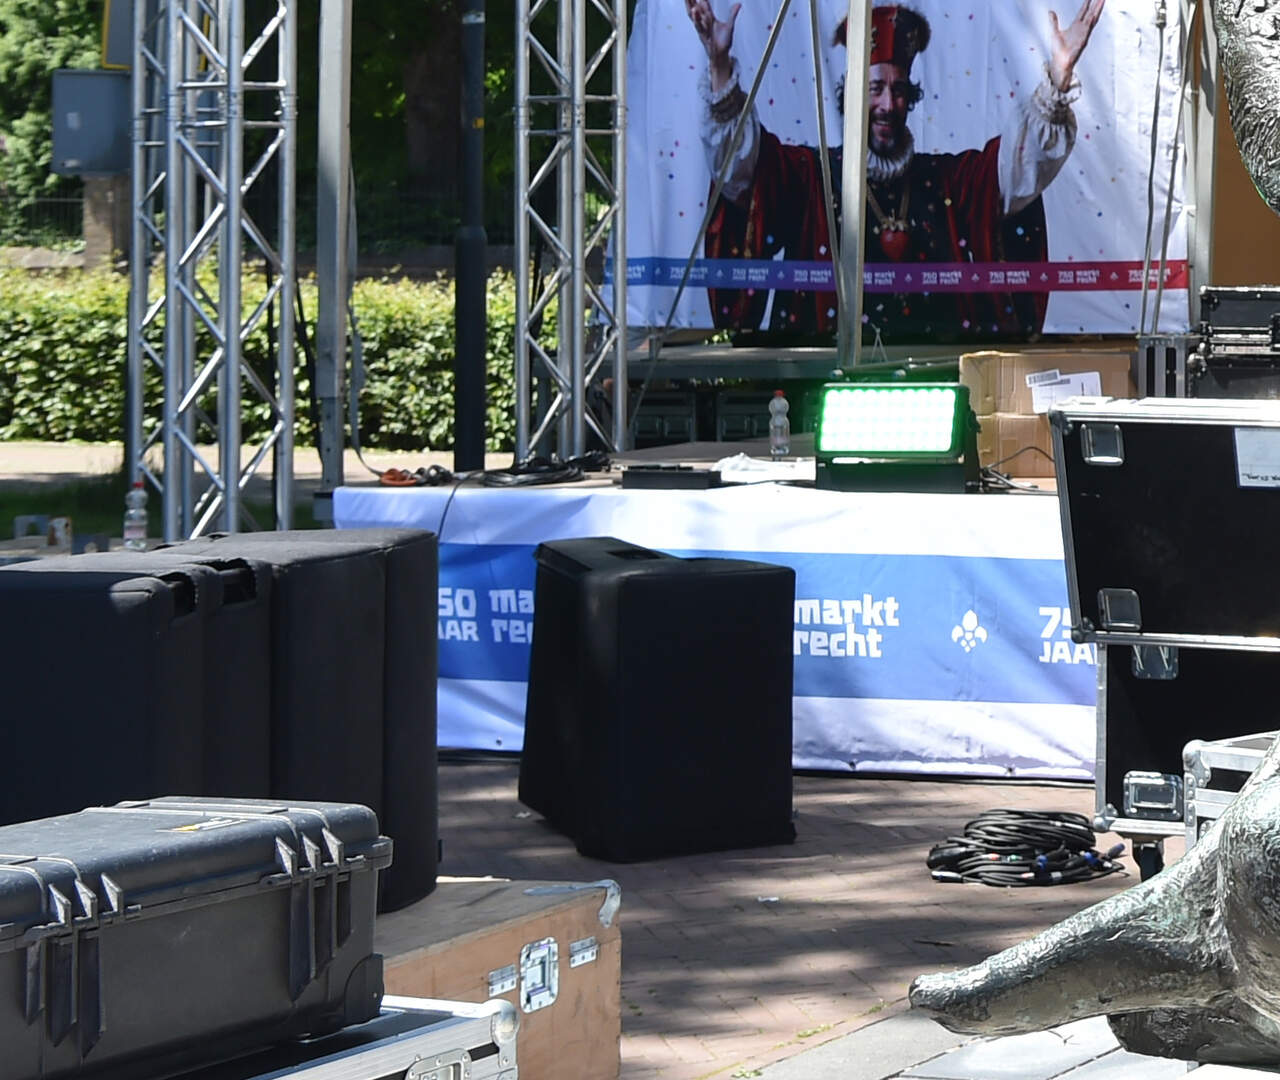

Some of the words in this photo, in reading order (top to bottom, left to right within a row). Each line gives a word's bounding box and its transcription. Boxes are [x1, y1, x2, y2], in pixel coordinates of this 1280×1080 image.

[438, 587, 477, 618] 50
[794, 593, 900, 627] markt
[438, 620, 480, 642] AR
[794, 623, 883, 658] recht
[1039, 641, 1098, 665] JAA
